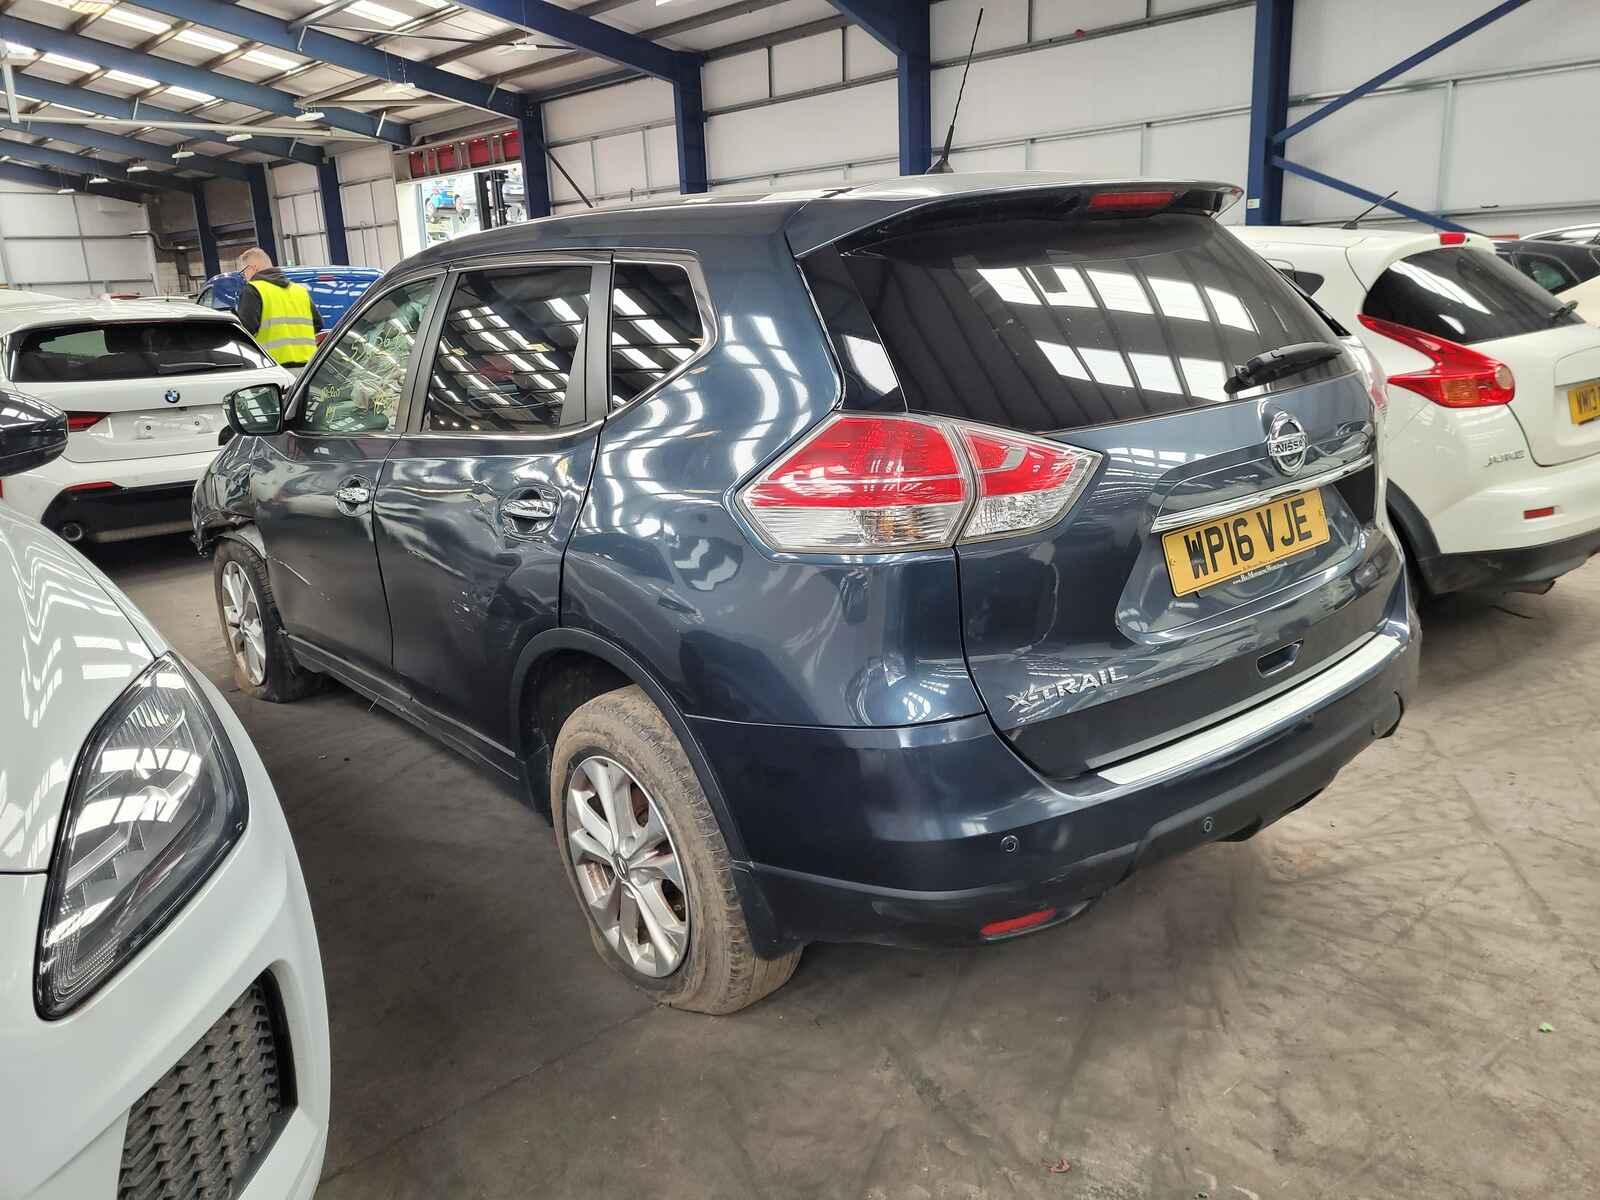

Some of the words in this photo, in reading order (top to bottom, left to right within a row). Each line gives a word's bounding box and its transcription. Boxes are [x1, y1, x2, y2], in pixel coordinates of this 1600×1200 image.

[1275, 438, 1306, 454] NISSA
[1183, 517, 1255, 579] WP16
[1256, 498, 1313, 552] VJE
[1005, 666, 1129, 712] X-TRAIL
